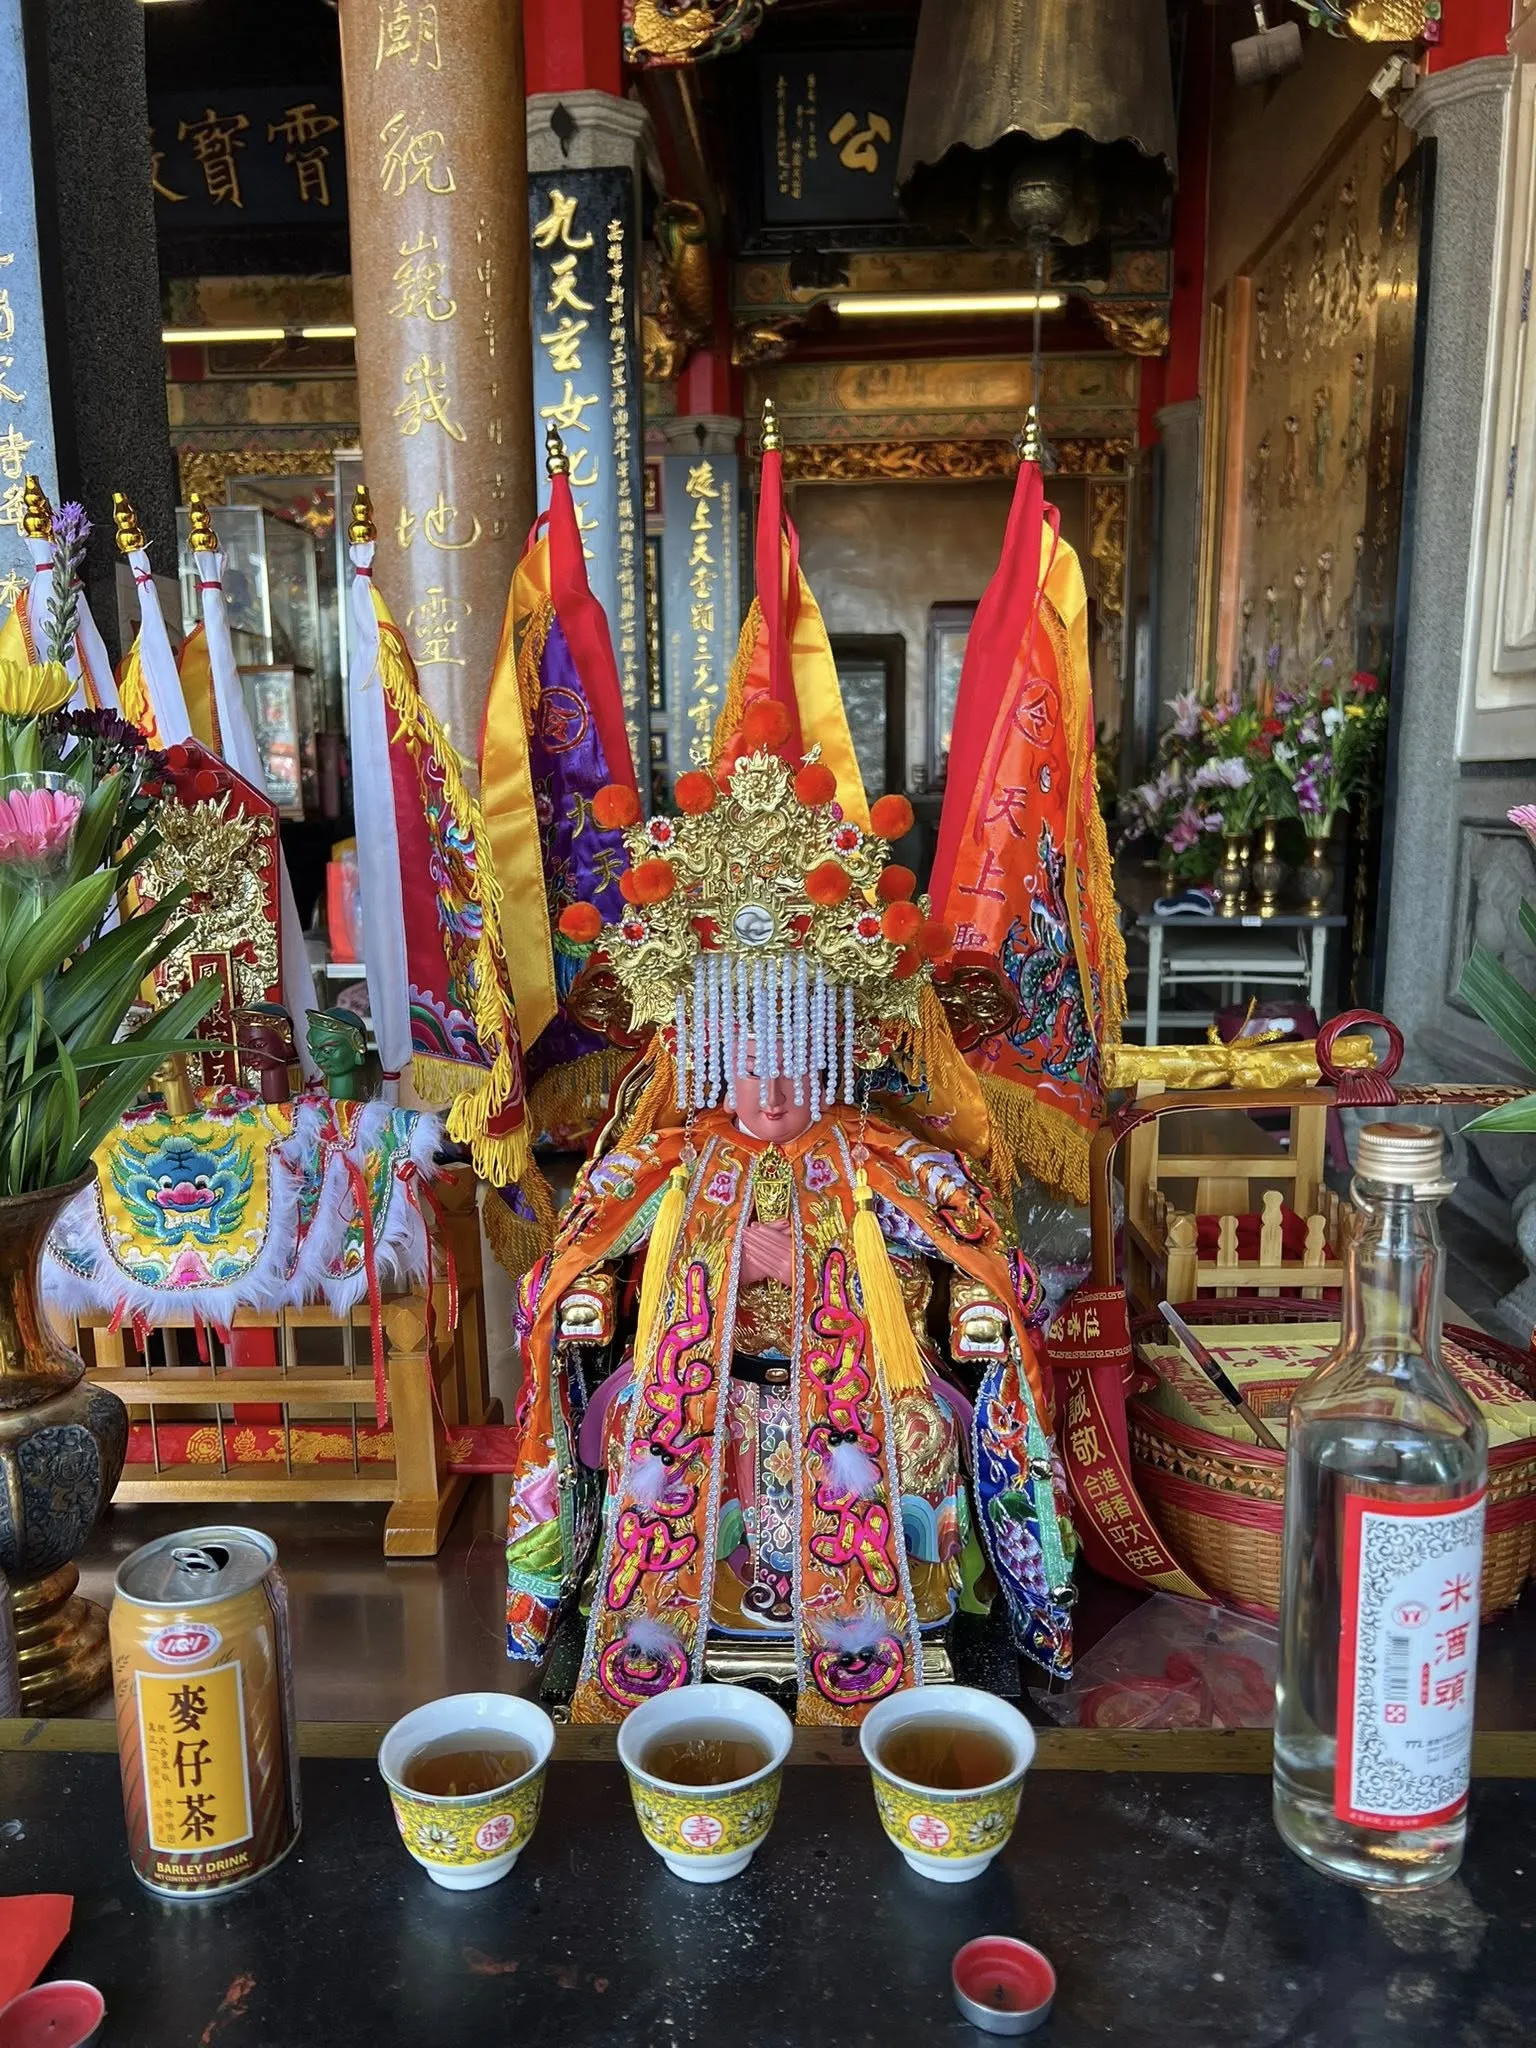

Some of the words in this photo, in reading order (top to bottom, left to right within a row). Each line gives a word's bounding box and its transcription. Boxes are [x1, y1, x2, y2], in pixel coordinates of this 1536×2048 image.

[828, 111, 892, 174] 公
[1083, 1474, 1151, 1570] 合境平安
[1099, 1467, 1165, 1567] 進香大吉
[1433, 1572, 1471, 1711] 米酒頭
[167, 1684, 217, 1842] 麥仔茶
[156, 1861, 203, 1876] BARLEY
[205, 1851, 249, 1873] DRINK
[686, 1814, 722, 1847] 壽
[909, 1814, 948, 1847] 壽
